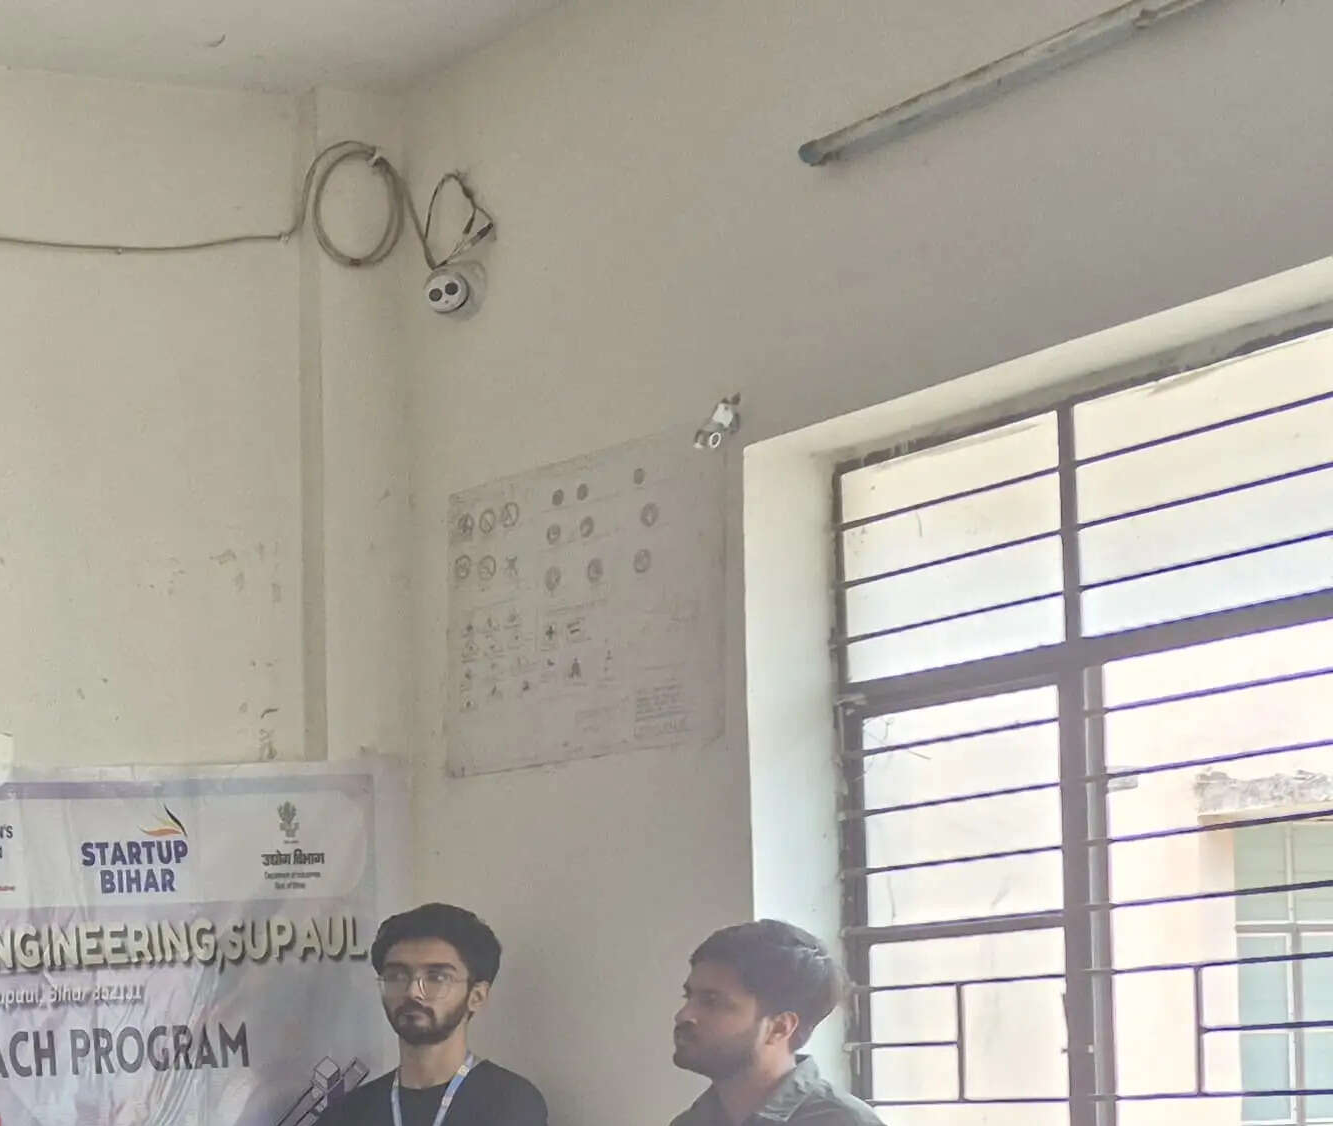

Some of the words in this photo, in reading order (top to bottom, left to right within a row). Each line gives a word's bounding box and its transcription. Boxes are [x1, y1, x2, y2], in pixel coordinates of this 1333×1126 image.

[81, 839, 189, 868] STARTUP
[100, 867, 177, 895] BIHAR
[70, 1022, 251, 1075] PROGRAM
